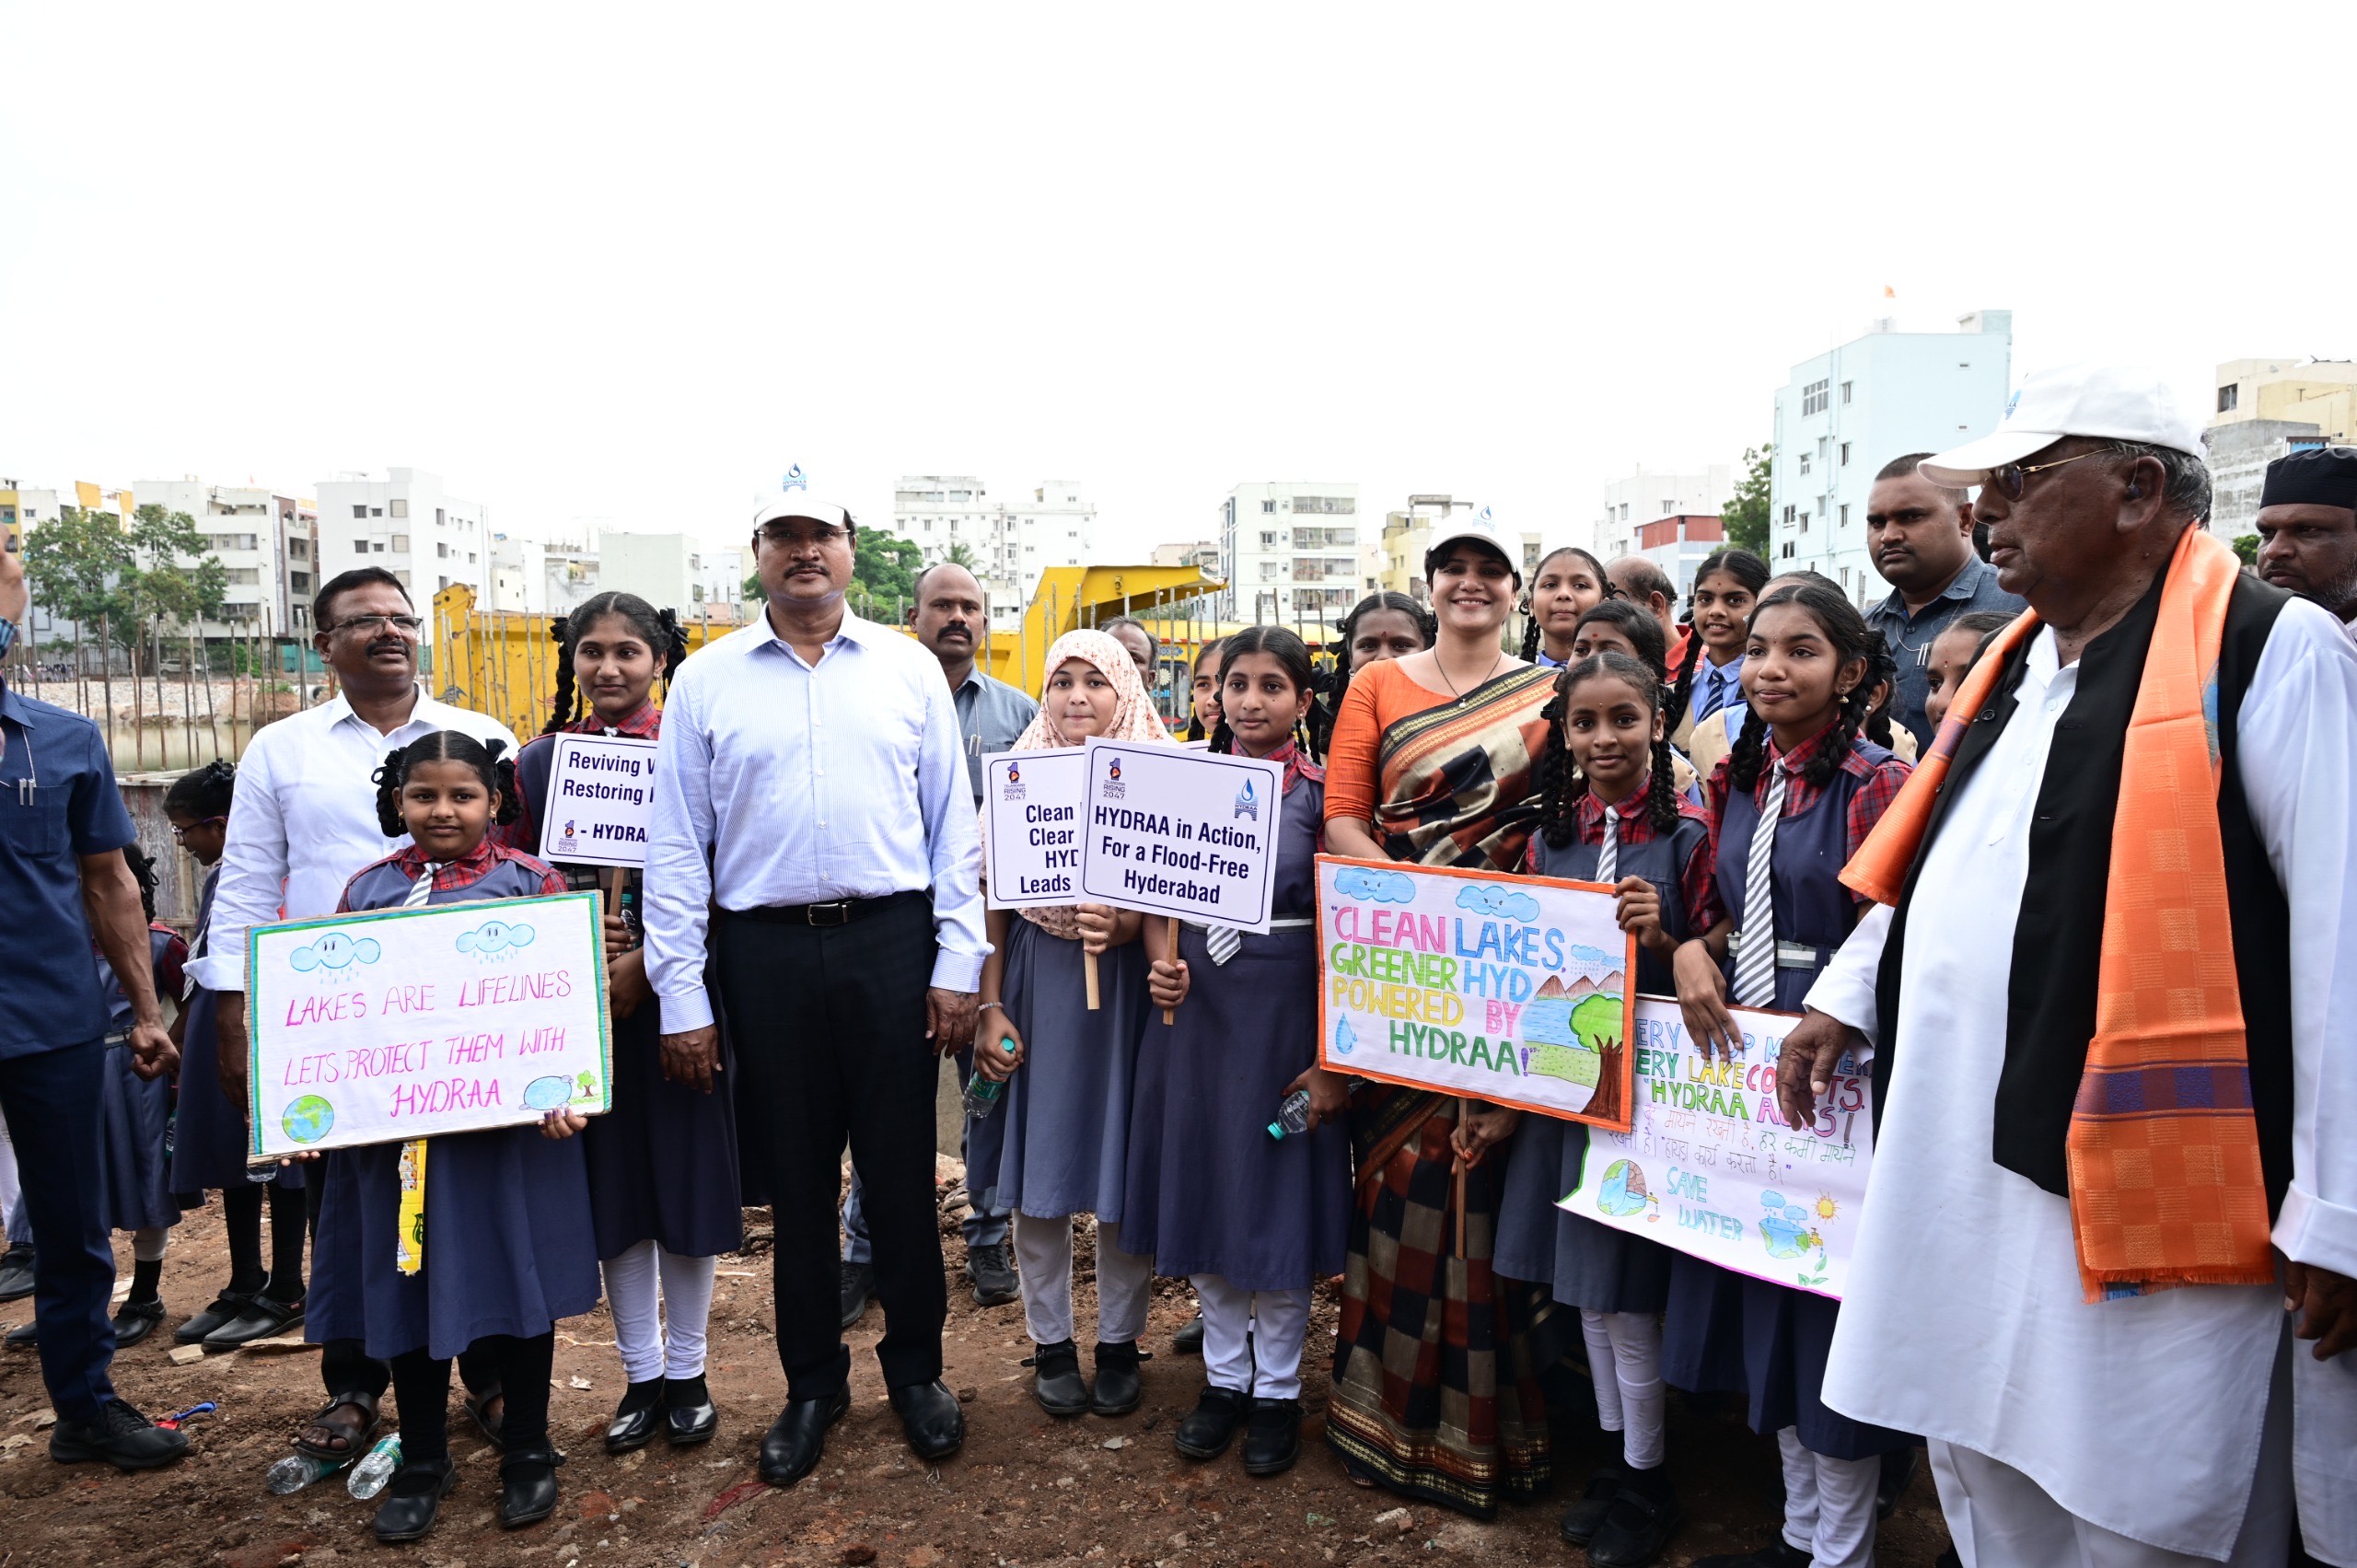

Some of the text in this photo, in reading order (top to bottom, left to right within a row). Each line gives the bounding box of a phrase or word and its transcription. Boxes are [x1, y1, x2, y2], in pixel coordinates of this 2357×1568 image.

[568, 751, 641, 777] Reviving
[563, 779, 644, 806] Restoring
[1026, 805, 1074, 823] Clean
[1095, 806, 1170, 836] HYDRAA
[1176, 819, 1192, 840] in
[1198, 822, 1261, 854] Action,
[593, 823, 649, 842] HYDRA
[1029, 828, 1074, 846] Clear
[1102, 836, 1249, 878] For a Flood-Free
[1020, 874, 1071, 894] Leads
[1124, 869, 1221, 904] Hyderabad
[1330, 943, 1533, 1003] GREENER HYD
[285, 970, 572, 1027] LAKES ARE LIFELINES
[1332, 976, 1521, 1038] POWERED BY
[1635, 1018, 1682, 1050] ERY
[284, 1027, 566, 1086] LETS PROTECT THEM WITH
[1635, 1049, 1679, 1078] ERY
[1689, 1056, 1746, 1089] LAKE
[389, 1078, 502, 1118] HYDRAA
[1666, 1167, 1707, 1202] SAVE
[1678, 1204, 1743, 1241] WATER
